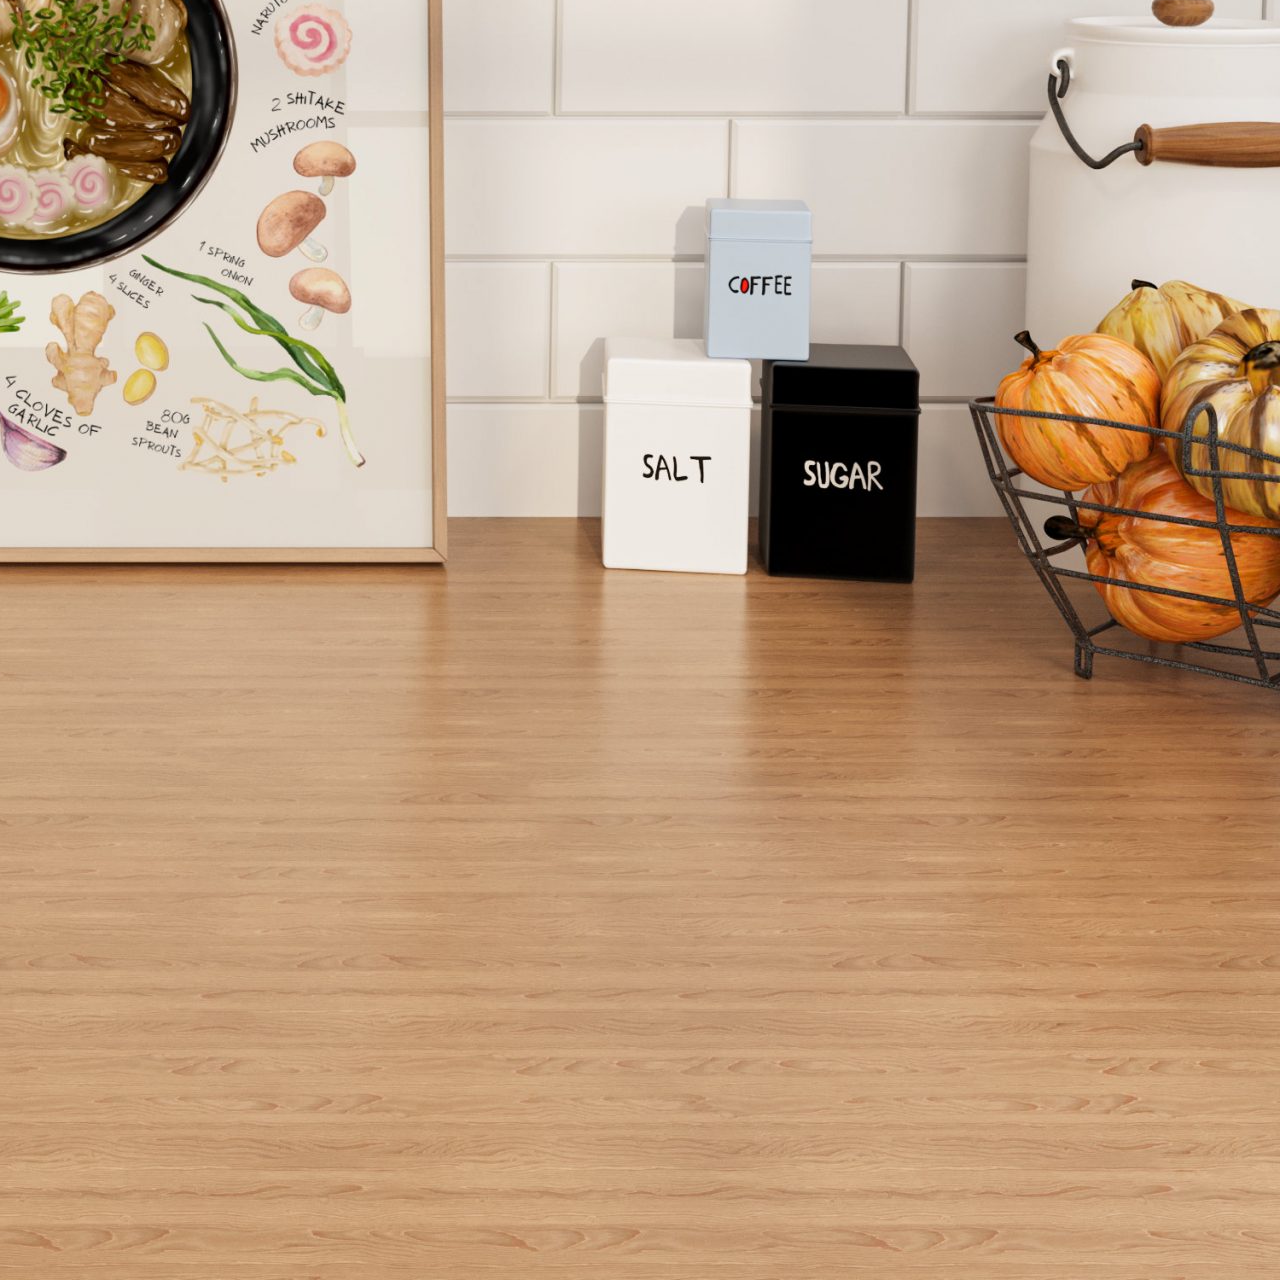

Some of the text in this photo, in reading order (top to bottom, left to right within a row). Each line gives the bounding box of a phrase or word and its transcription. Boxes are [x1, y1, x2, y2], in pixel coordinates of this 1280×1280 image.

[271, 90, 346, 116] 2 SHITAKE
[250, 116, 336, 153] MUSHROOMS
[199, 241, 245, 268] 1 SPRING
[109, 273, 151, 309] 4 SLICES
[129, 269, 165, 297] GINGER
[220, 268, 254, 286] ONION
[728, 274, 793, 296] COFFEE
[5, 375, 103, 436] 4 CLOVES OF
[7, 403, 60, 437] GARLIC
[145, 421, 180, 438] BEAN
[131, 437, 182, 457] SPROUTS
[641, 452, 713, 484] SALT
[802, 459, 885, 492] SUGAR
